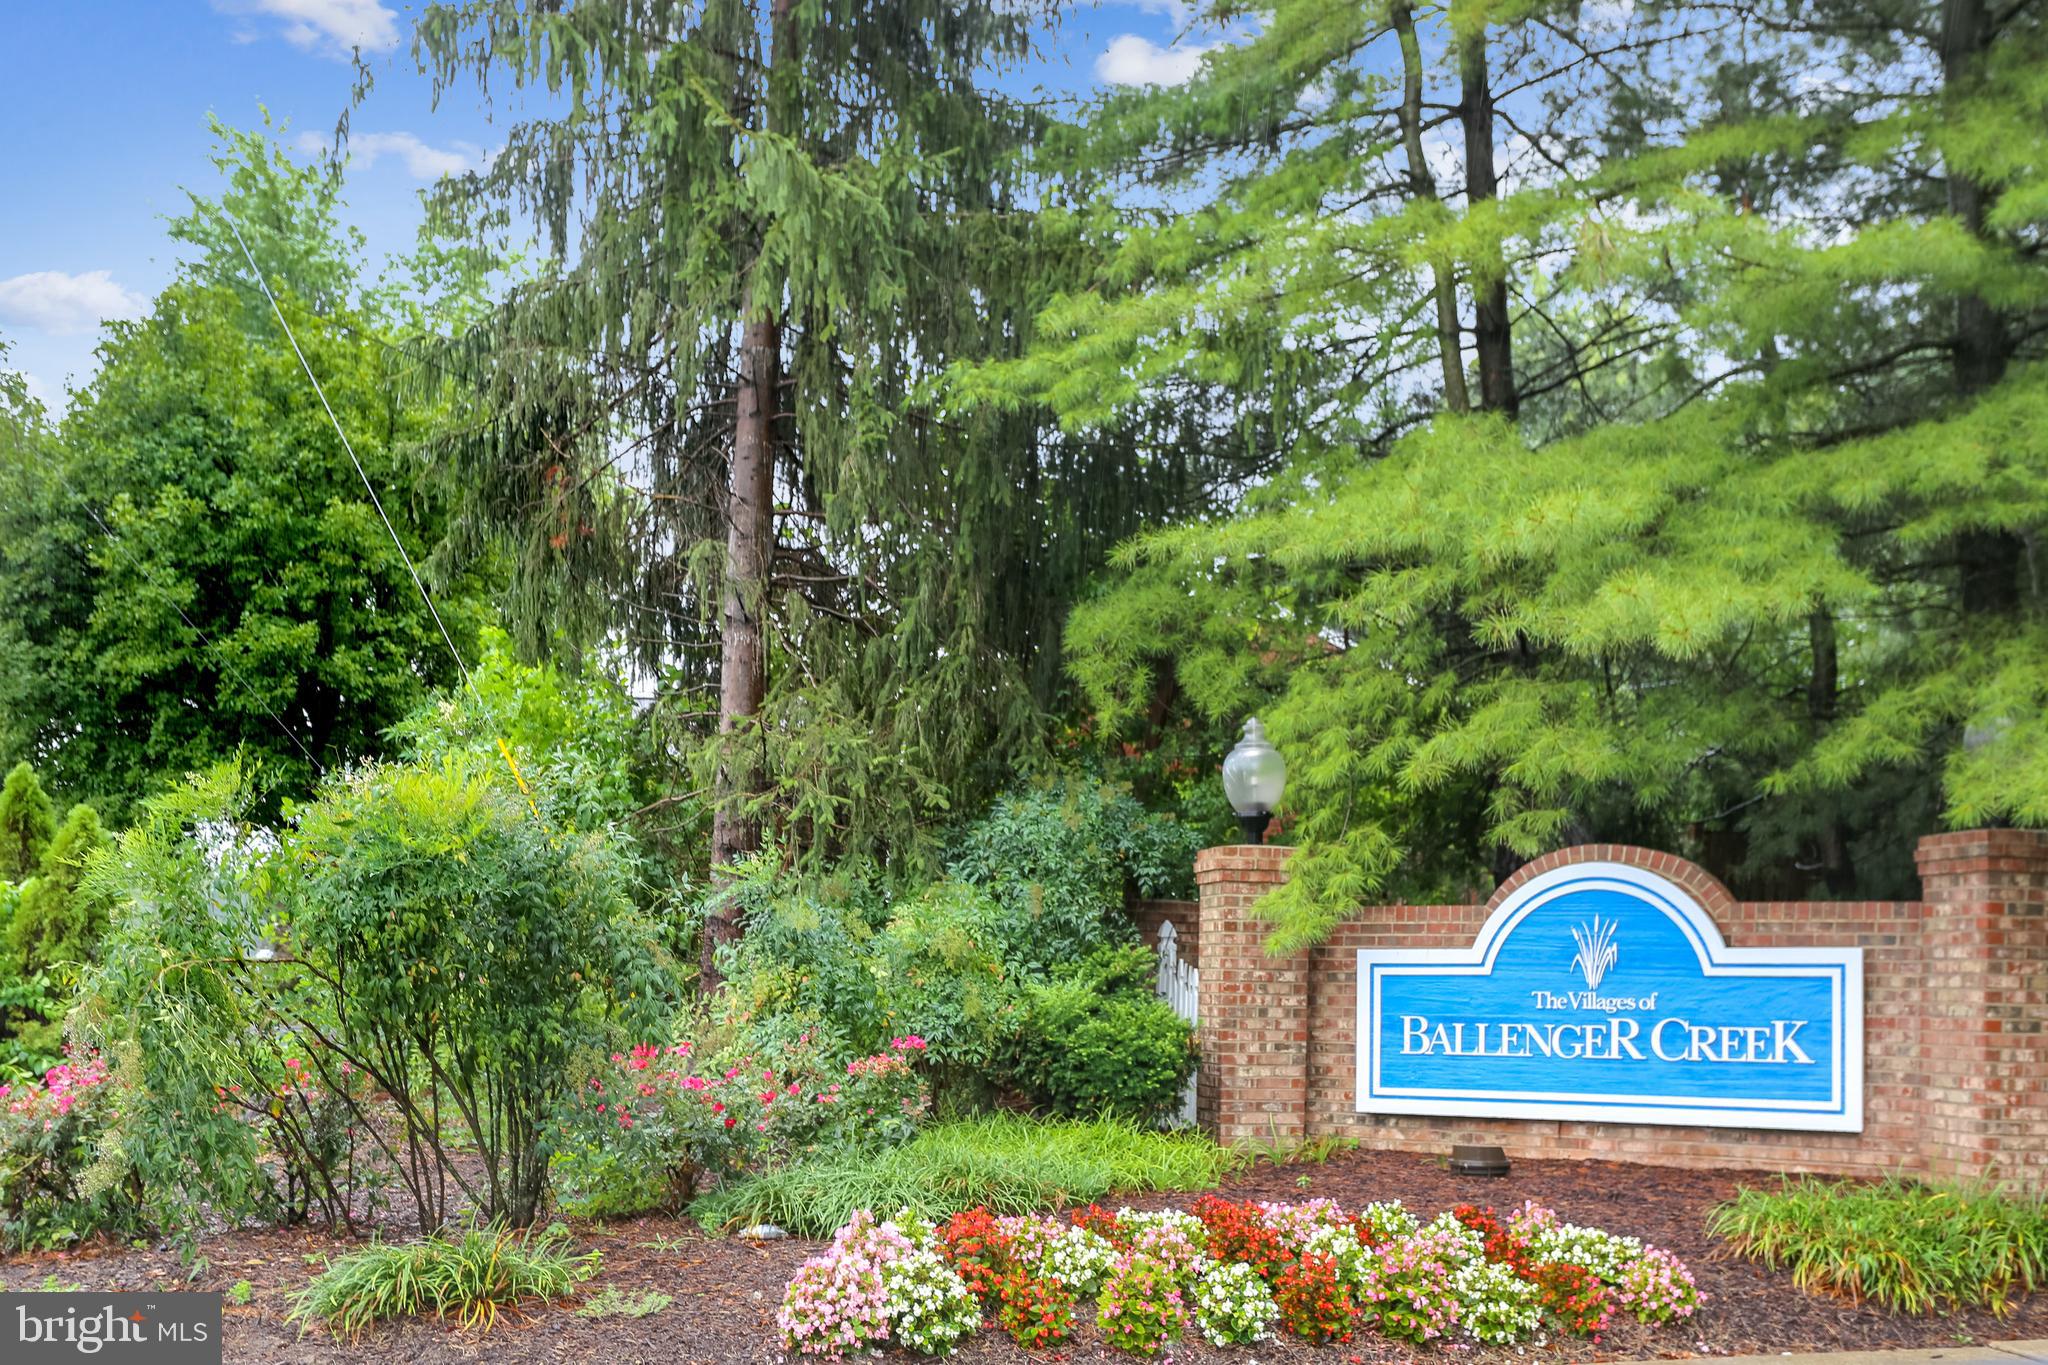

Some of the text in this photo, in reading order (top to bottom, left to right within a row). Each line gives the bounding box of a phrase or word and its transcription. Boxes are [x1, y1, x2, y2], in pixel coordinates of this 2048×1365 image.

[1531, 990, 1659, 1013] The Villages of
[1400, 1015, 1816, 1064] BALLENGER CREEK
